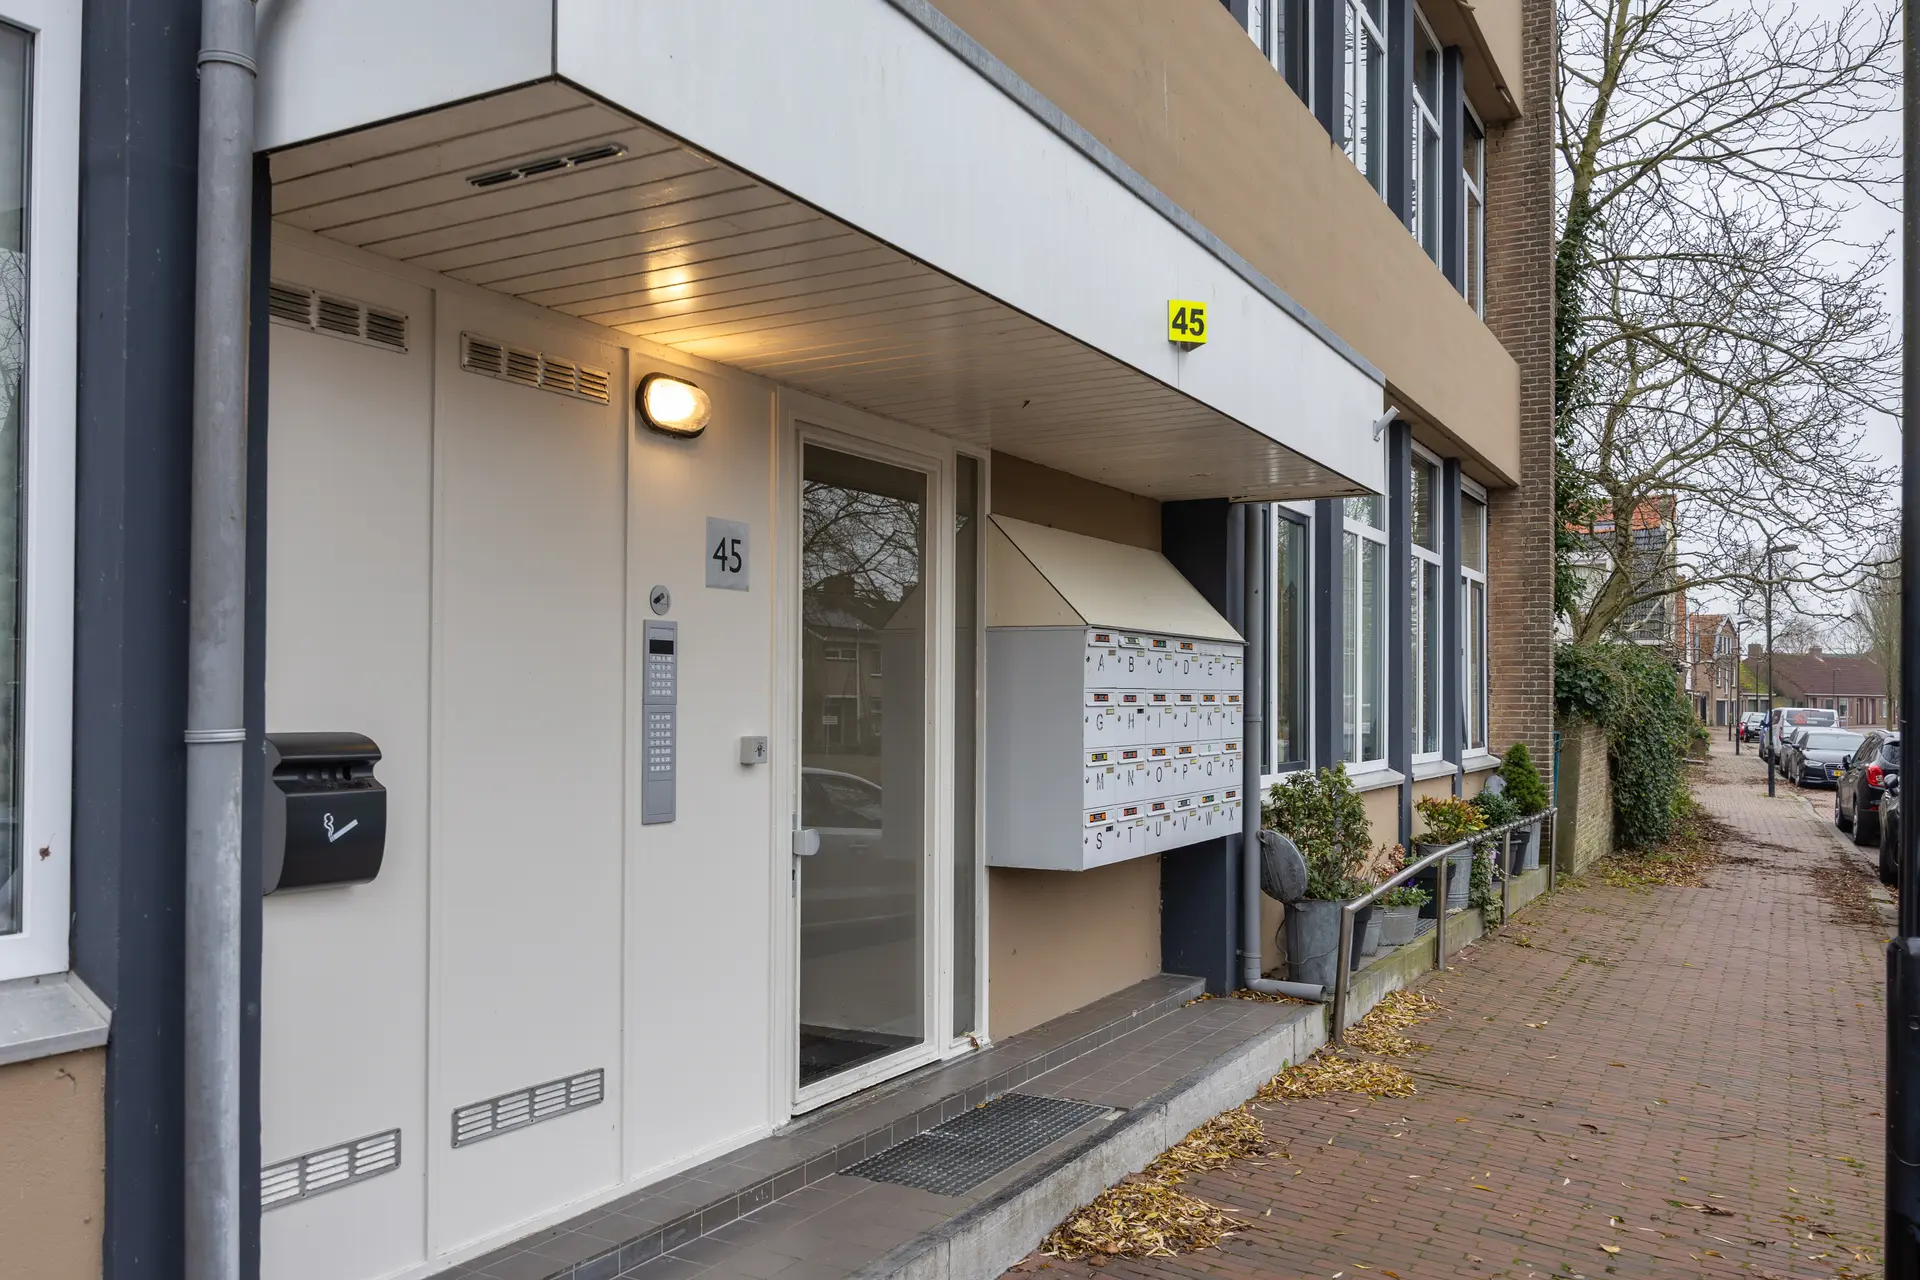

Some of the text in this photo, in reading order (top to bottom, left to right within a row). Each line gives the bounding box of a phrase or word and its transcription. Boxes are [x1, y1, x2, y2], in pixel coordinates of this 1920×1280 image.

[1172, 307, 1204, 336] 45
[713, 537, 742, 573] 45
[1098, 654, 1104, 671] A
[1129, 657, 1134, 672] B
[1157, 658, 1162, 673] C
[1184, 660, 1189, 674] D
[1208, 662, 1212, 675] E
[1231, 663, 1234, 675] F
[1096, 714, 1103, 730] G
[1128, 713, 1134, 729] H
[1184, 712, 1187, 727] J
[1207, 712, 1212, 726] K
[1231, 711, 1234, 724] L
[1183, 764, 1188, 779] P
[1207, 761, 1212, 776] Q
[1229, 759, 1234, 772] R
[1097, 773, 1104, 790] M
[1128, 770, 1134, 786] N
[1156, 767, 1162, 782] O
[1206, 812, 1212, 826] W
[1229, 807, 1234, 821] X
[1156, 822, 1161, 837] U
[1182, 816, 1187, 831] V
[1096, 833, 1102, 849] S
[1128, 827, 1133, 842] T
